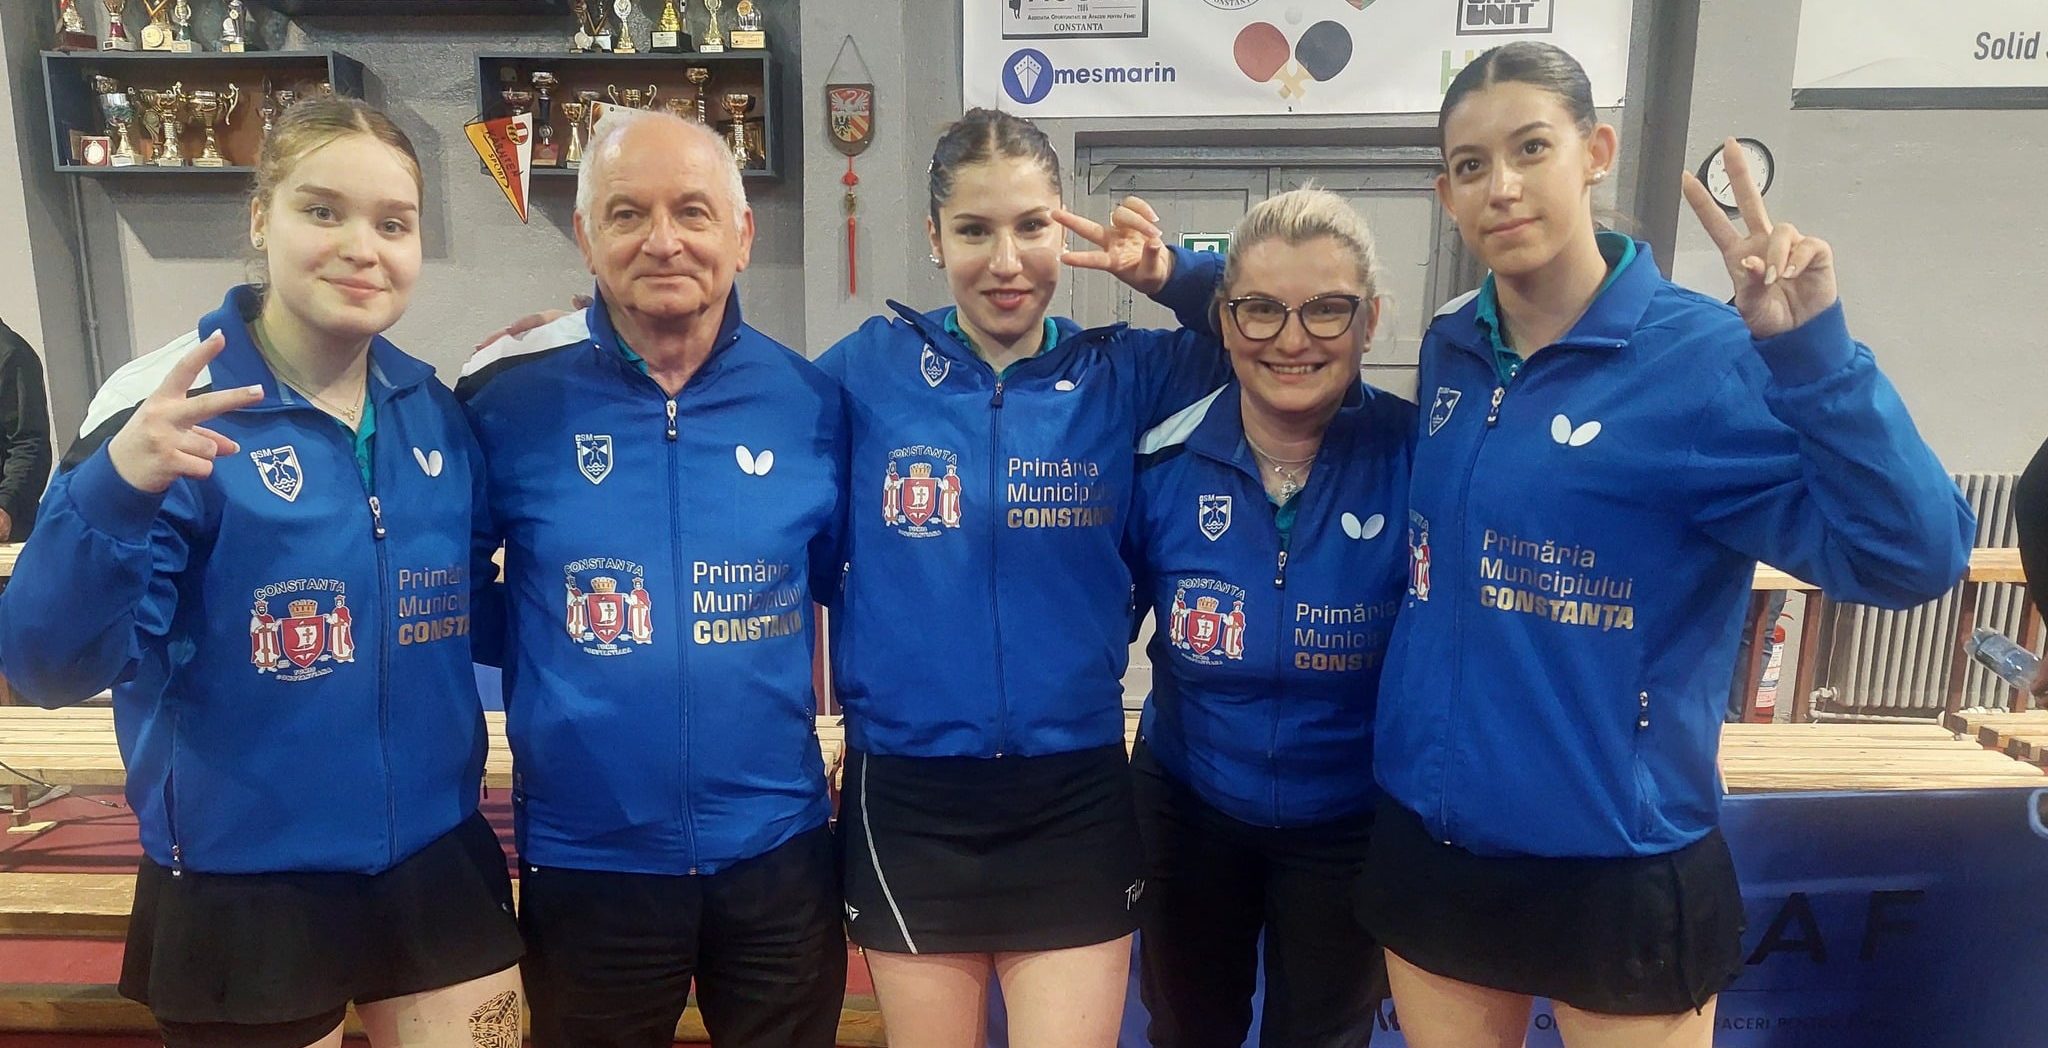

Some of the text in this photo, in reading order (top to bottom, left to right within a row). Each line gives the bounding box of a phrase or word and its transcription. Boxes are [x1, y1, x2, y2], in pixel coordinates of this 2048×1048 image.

[1466, 3, 1535, 25] UNIT
[1054, 23, 1103, 31] CONSTANTA
[1974, 31, 2041, 60] Solid
[1055, 61, 1176, 84] mesmarin
[489, 153, 506, 180] SPORT
[888, 445, 958, 465] CONSTANTA
[1483, 529, 1596, 568] Primăria
[564, 558, 643, 577] CONSTANTA
[1480, 556, 1634, 600] Municipiului
[253, 578, 346, 600] CONSTANTA
[1178, 578, 1247, 599] CONSTANTA
